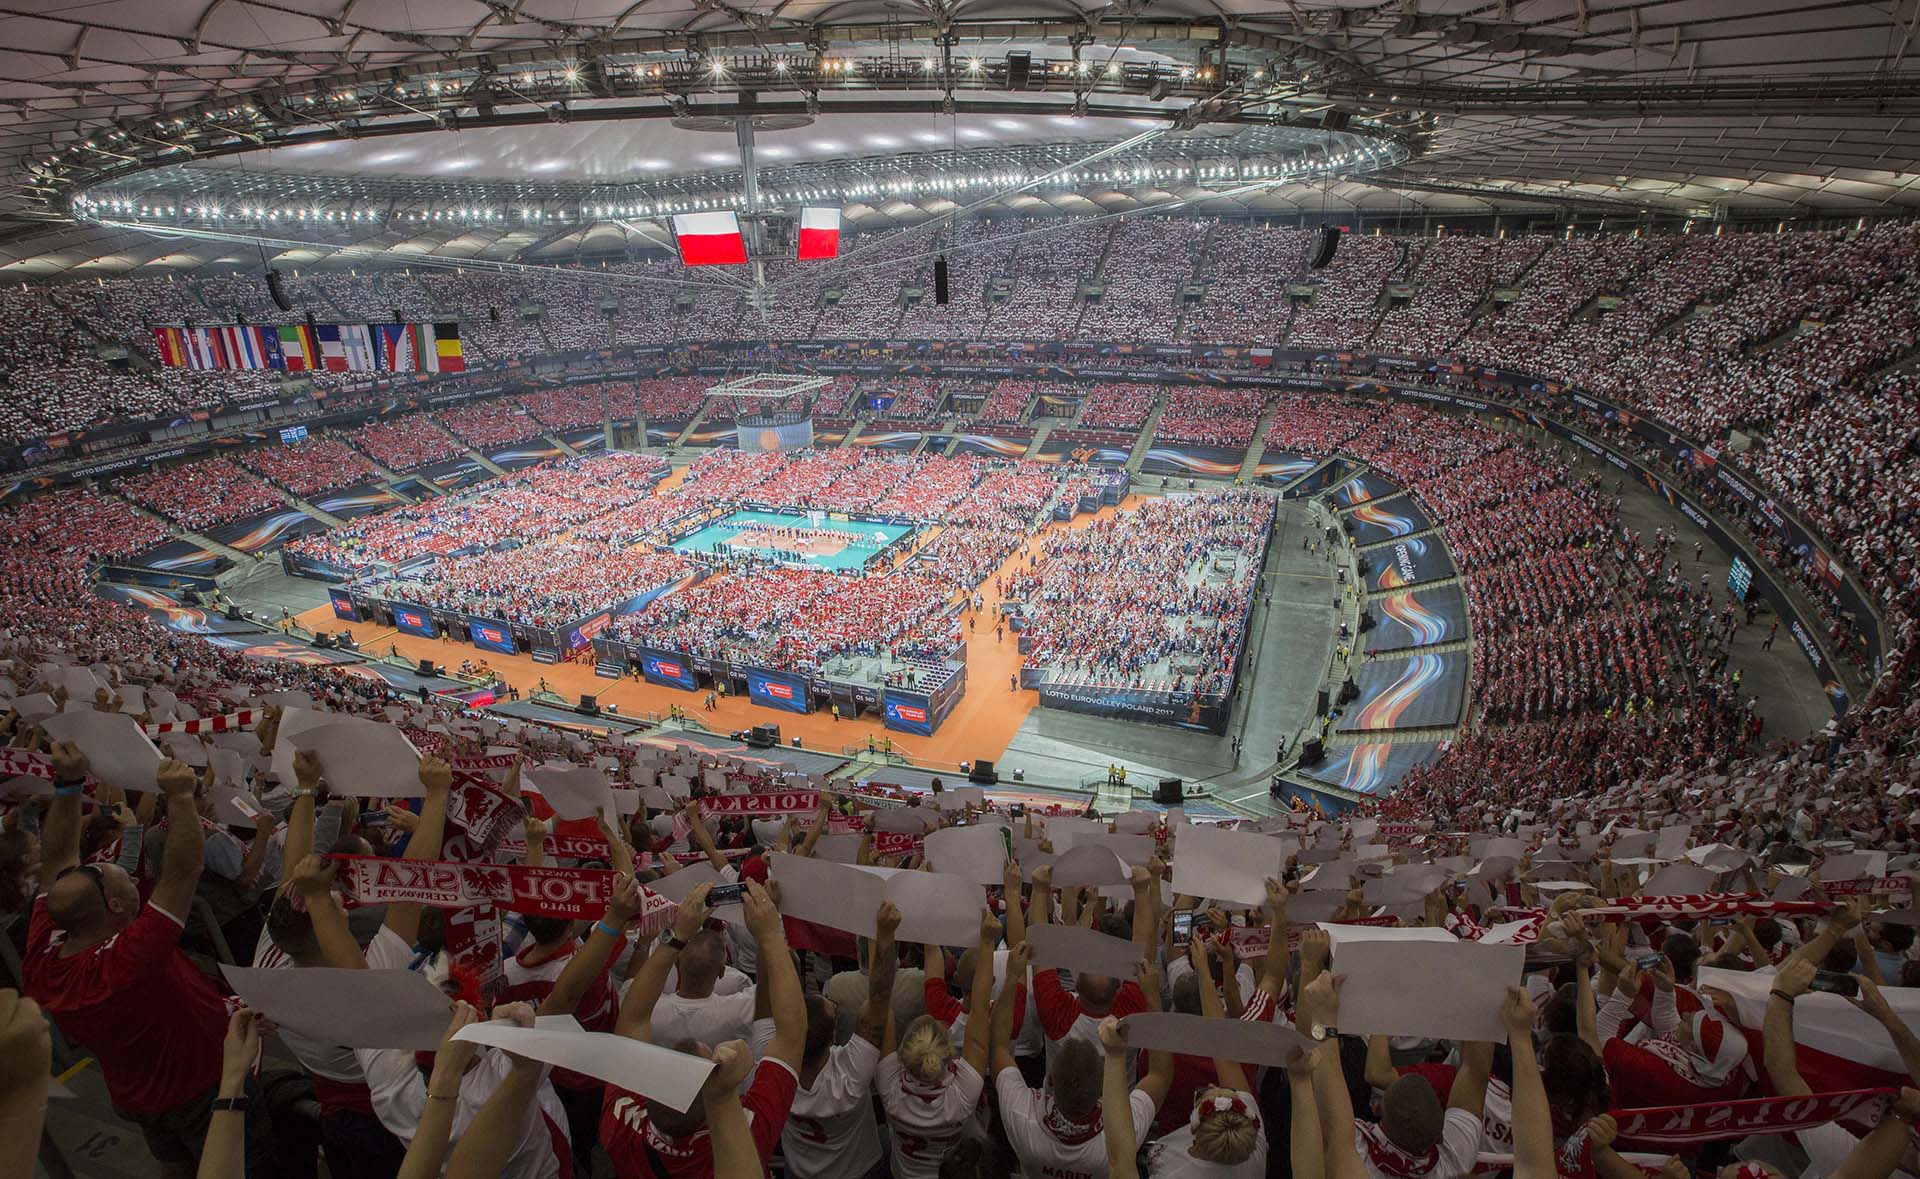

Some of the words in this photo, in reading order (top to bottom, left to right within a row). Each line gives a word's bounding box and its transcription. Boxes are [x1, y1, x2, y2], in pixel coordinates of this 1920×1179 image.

[1378, 358, 1401, 366] OPENING
[239, 403, 264, 411] OPENING
[1418, 392, 1450, 402] EUROVOLLEY
[1456, 399, 1476, 408] POLAND
[72, 469, 94, 478] LOTTO
[95, 458, 138, 474] EUROVOLLEY
[145, 452, 171, 462] POLAND
[171, 449, 186, 458] 2017
[433, 470, 463, 482] OPENING
[464, 465, 482, 474] GAME
[685, 526, 702, 536] POLAND
[1395, 544, 1410, 568] OPENING
[1402, 564, 1416, 580] GAME
[1046, 690, 1070, 700] LOTTO
[1071, 695, 1121, 708] EUROVOLLEY
[1122, 702, 1154, 713] POLAND
[1155, 708, 1174, 716] 2017
[646, 897, 667, 911] POL
